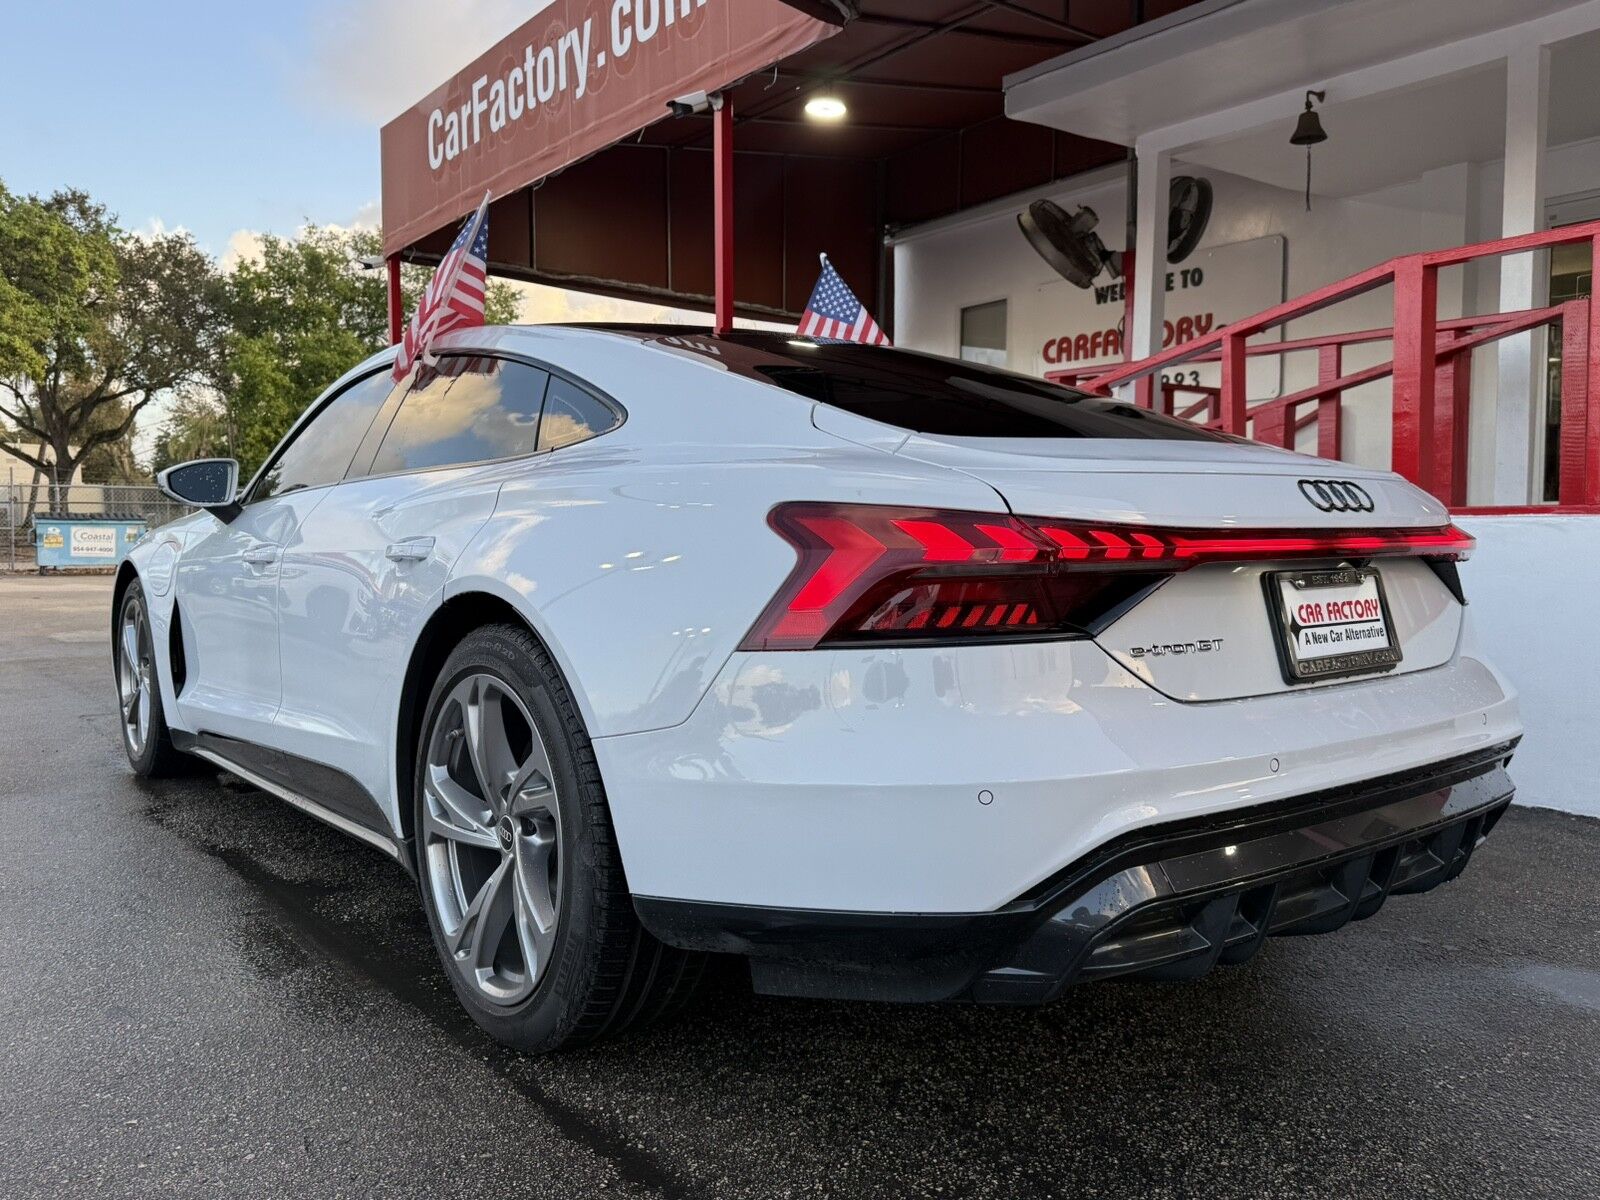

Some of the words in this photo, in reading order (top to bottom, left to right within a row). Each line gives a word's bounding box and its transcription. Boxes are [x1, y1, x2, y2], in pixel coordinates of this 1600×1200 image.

[1094, 272, 1175, 305] WELE
[1180, 267, 1204, 289] TO
[1042, 313, 1213, 364] CARFAORY
[80, 531, 114, 541] Coastal
[1298, 603, 1324, 623] CAR
[1326, 598, 1379, 621] FACTORY
[1305, 632, 1312, 646] A
[1312, 631, 1329, 645] New
[1330, 629, 1345, 643] Car
[1345, 625, 1385, 640] Alternative
